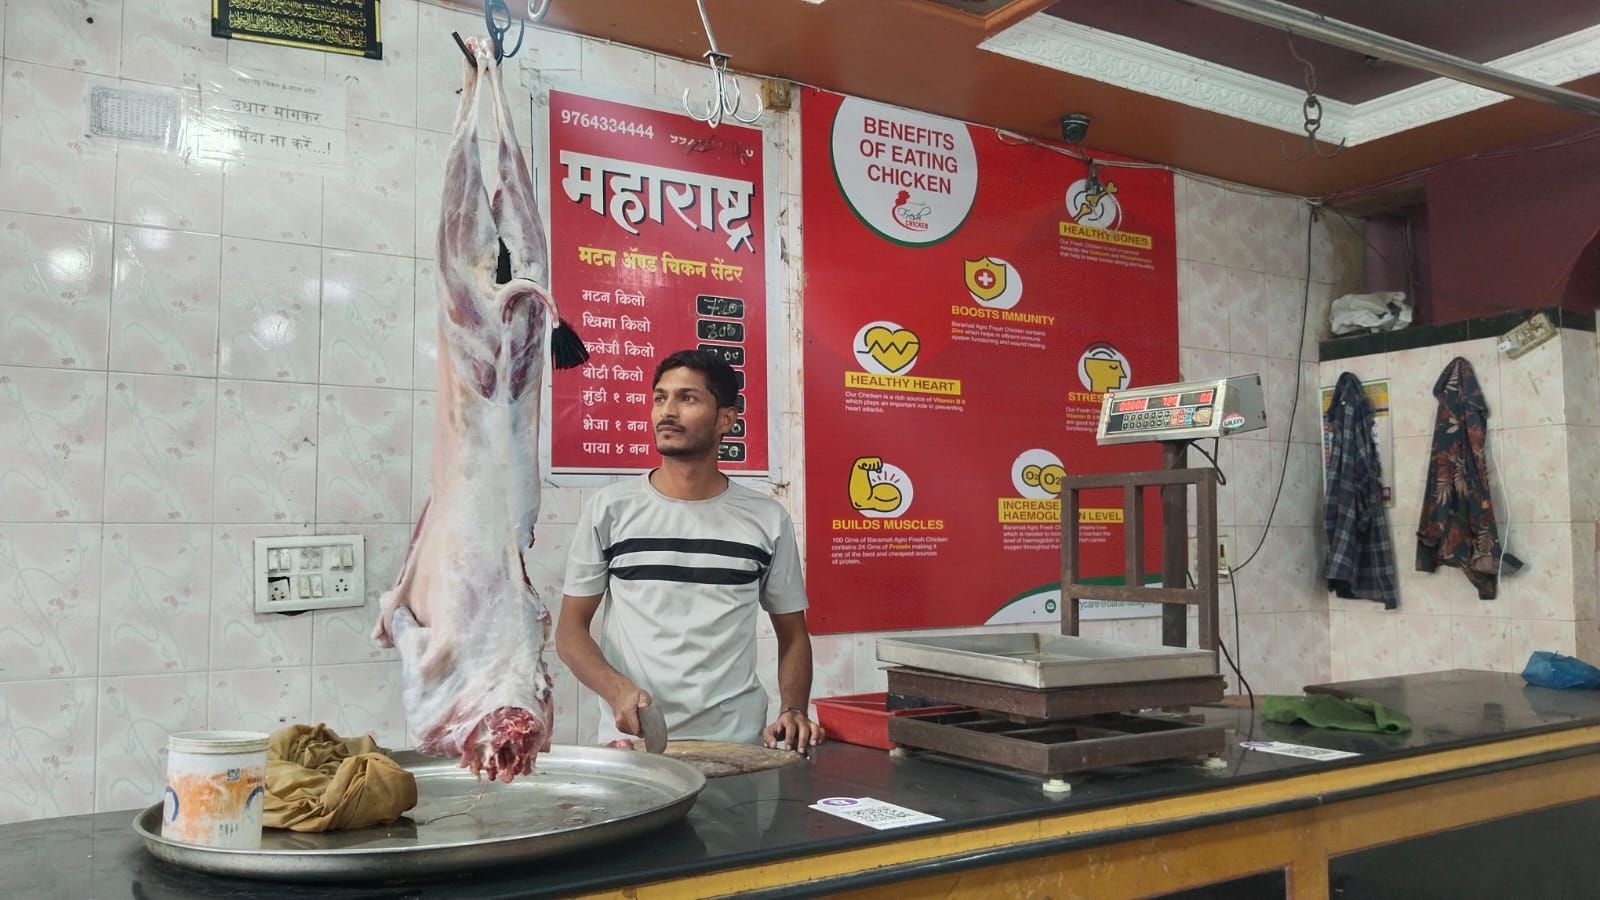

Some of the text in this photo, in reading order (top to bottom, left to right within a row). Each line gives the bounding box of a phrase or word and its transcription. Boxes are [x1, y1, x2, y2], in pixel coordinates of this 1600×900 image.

[232, 99, 323, 122] उधार मांगकर
[561, 109, 655, 139] 9764334444
[864, 116, 955, 151] BENEFITS
[270, 135, 287, 148] ना
[860, 139, 958, 174] OF EATING
[867, 164, 951, 195] CHICKEN
[559, 149, 756, 254] महाराष्ट्र
[905, 219, 929, 229] CHICKEN
[1064, 225, 1149, 246] HEALTHY BONES
[578, 246, 617, 268] मटन
[662, 252, 706, 280] चिकन
[711, 258, 743, 283] सेंटर
[582, 289, 645, 307] मटन किलो
[582, 312, 651, 333] खिमा किलो
[952, 305, 1056, 325] BOOSTS IMMUNITY
[625, 340, 655, 358] किलो
[582, 363, 643, 382] बोटी किलो
[850, 375, 955, 391] HEALTHY HEART
[582, 387, 607, 406] मुंडी
[626, 392, 646, 404] नग
[1068, 392, 1104, 403] STRES
[583, 414, 608, 431] भेजा
[627, 420, 648, 432] नग
[582, 442, 610, 454] पाया
[629, 443, 650, 455] नग
[832, 519, 945, 530] BUILDS MUSCLES
[1003, 511, 1122, 521] HAEMOGLN LEVEL
[894, 536, 908, 545] Agro
